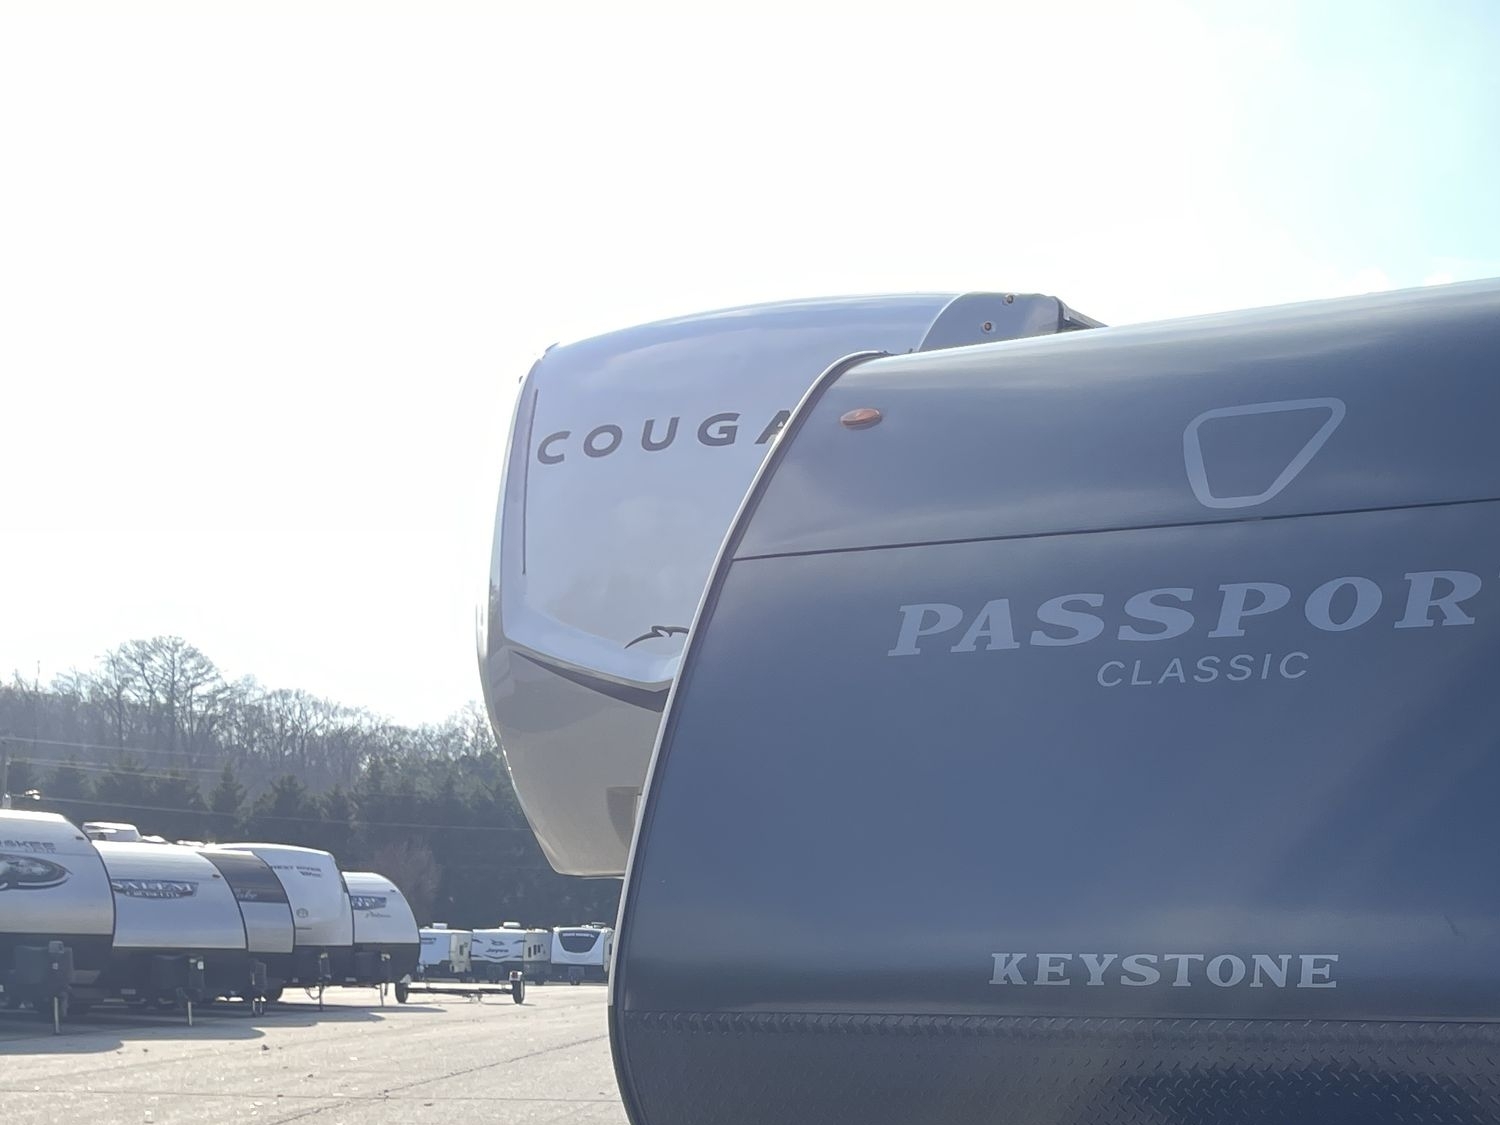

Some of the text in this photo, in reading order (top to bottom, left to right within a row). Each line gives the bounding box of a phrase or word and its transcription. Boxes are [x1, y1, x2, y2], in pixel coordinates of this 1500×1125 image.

[537, 409, 793, 465] COUGA
[1097, 651, 1309, 688] CLASSIC
[988, 952, 1340, 988] KEYSTONE
